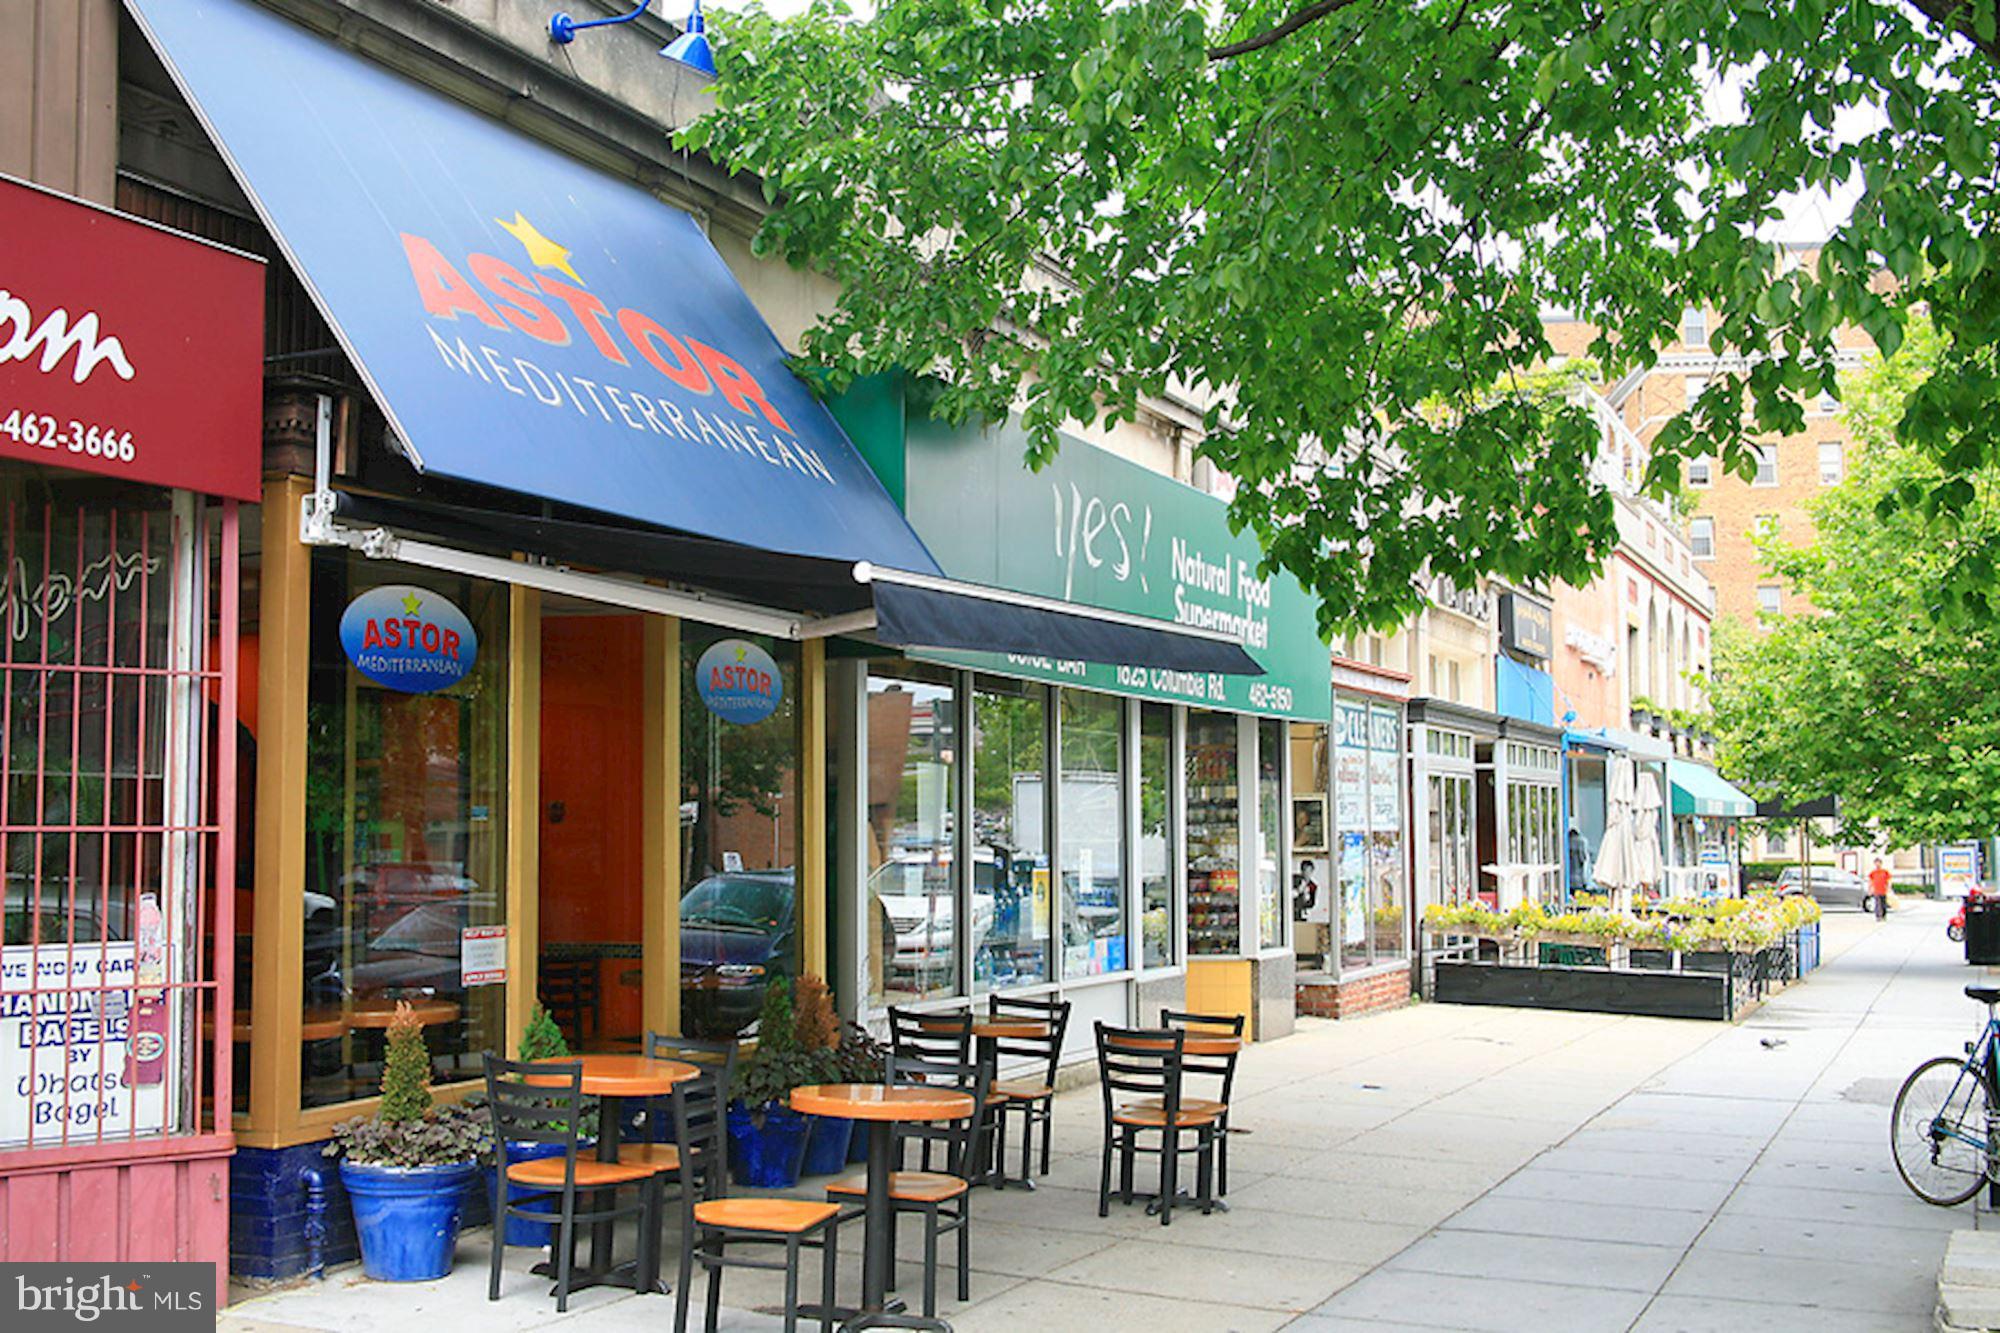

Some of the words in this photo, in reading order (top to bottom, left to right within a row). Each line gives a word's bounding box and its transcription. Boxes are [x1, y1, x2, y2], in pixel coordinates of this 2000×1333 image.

[399, 231, 796, 437] ASTOR
[425, 322, 837, 485] MEDITERRANEAN
[1052, 480, 1152, 602] Yes!
[1171, 536, 1231, 598] Natural
[1237, 559, 1271, 609] Food
[1174, 583, 1268, 650] Supermarket
[362, 617, 461, 661] ASTOR
[356, 653, 463, 677] MEDITERRANEAN
[709, 664, 772, 698] ASTOR
[1150, 668, 1206, 698] Columbia
[20, 1018, 129, 1047] BAGELS
[35, 1097, 119, 1125] Bagel
